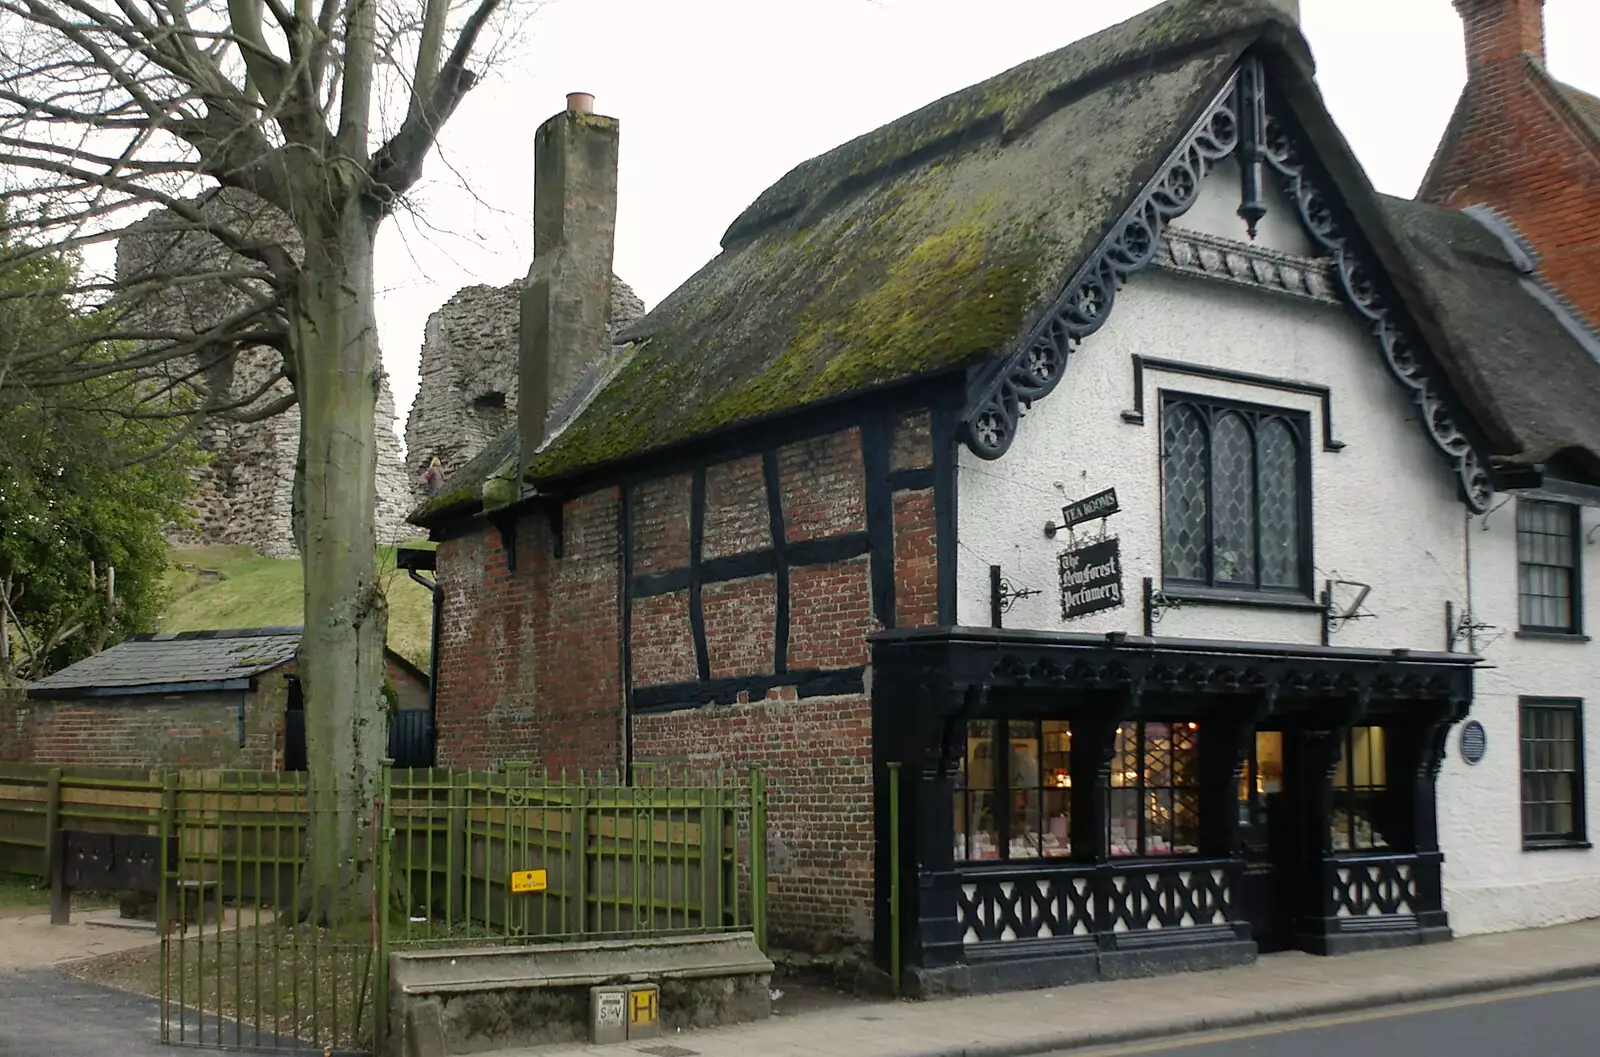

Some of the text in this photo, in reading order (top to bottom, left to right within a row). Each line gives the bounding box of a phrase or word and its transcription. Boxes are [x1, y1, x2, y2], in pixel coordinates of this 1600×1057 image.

[1064, 492, 1116, 521] TEA ROOMS
[1062, 554, 1079, 569] The
[1064, 583, 1120, 612] Perfumery
